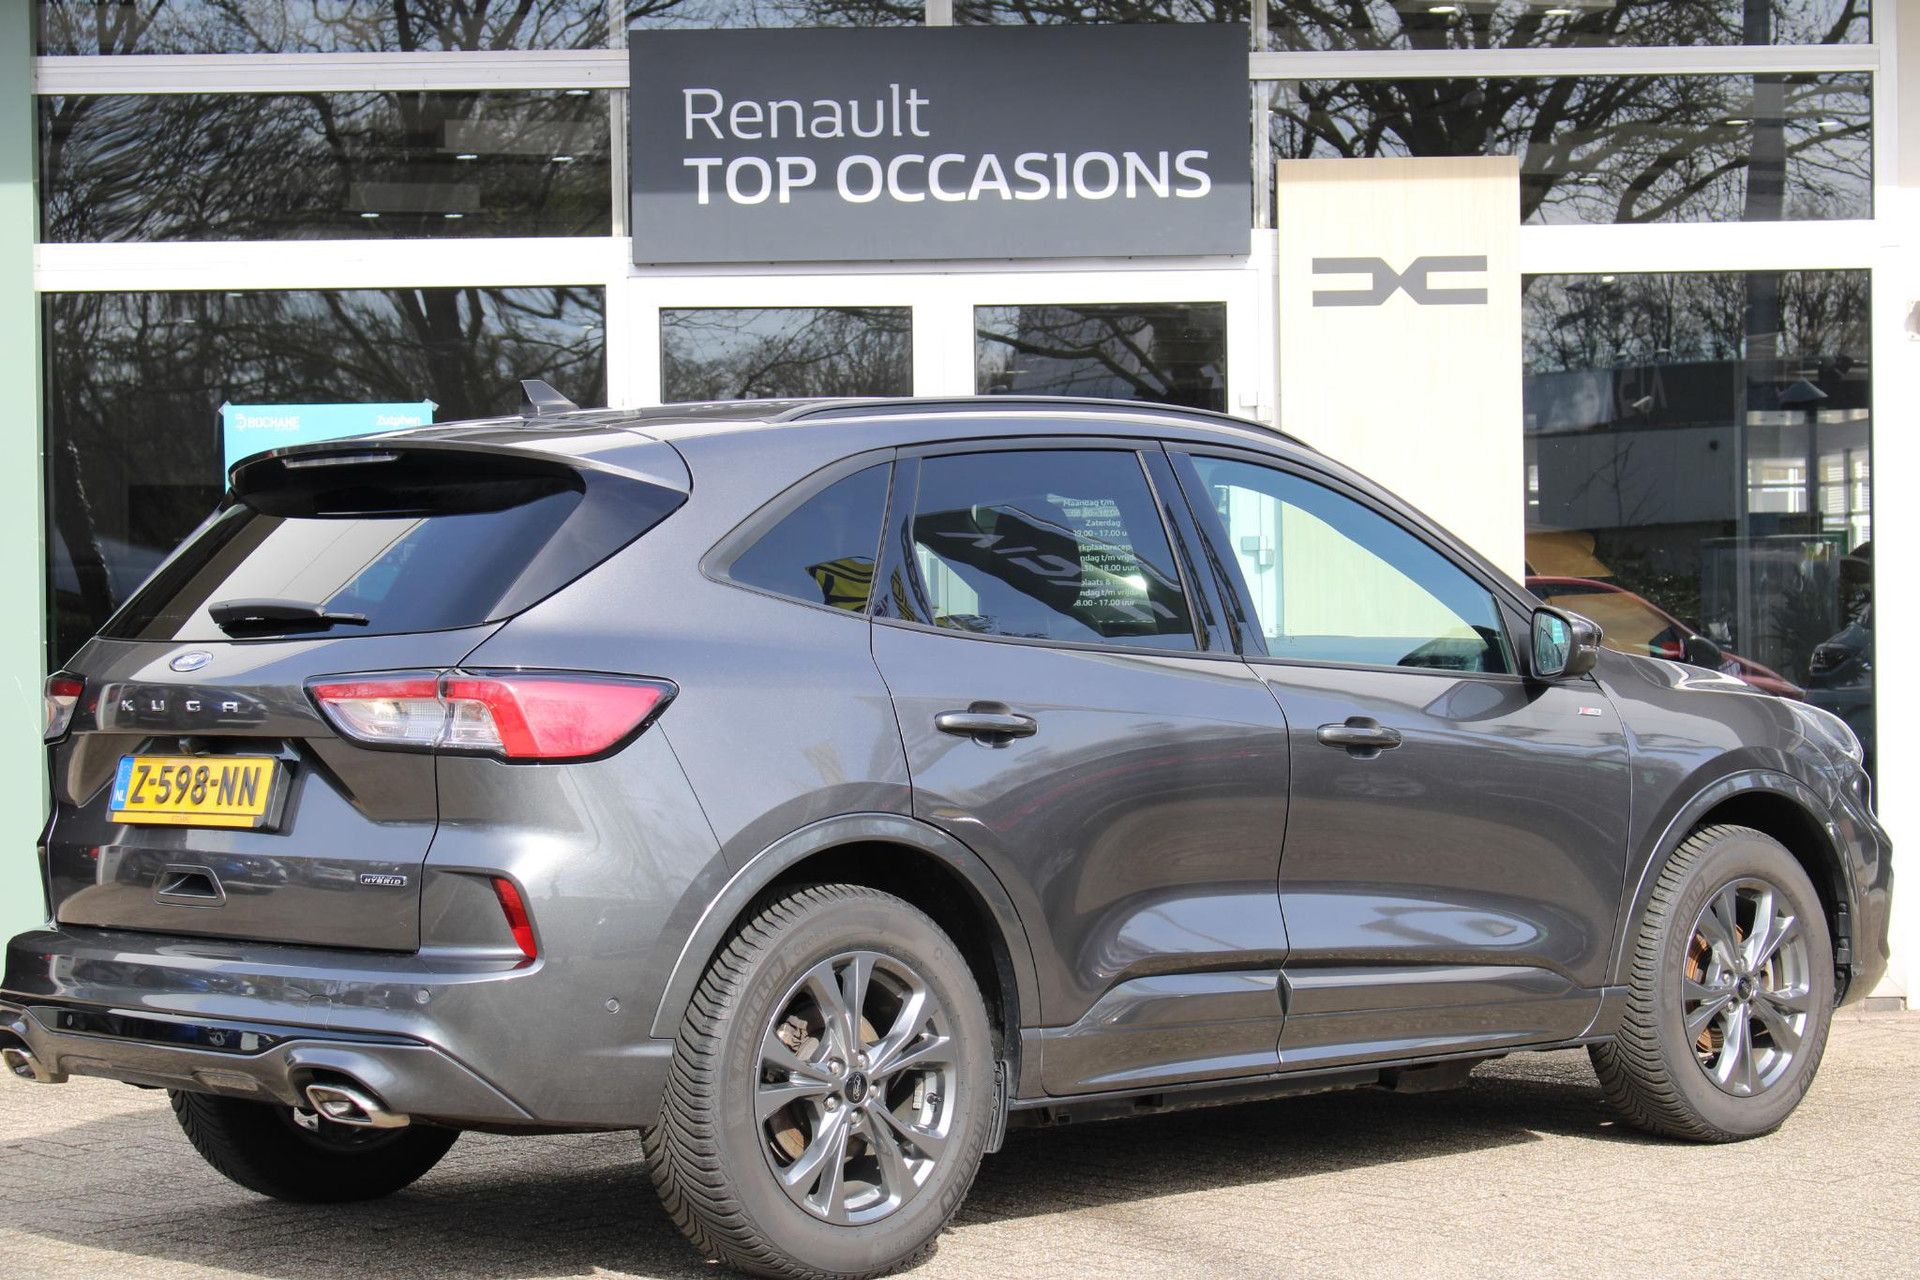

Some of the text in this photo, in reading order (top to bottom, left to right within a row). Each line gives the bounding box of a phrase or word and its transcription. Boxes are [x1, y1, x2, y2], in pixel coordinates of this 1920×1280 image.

[682, 83, 930, 141] Renault
[682, 150, 1212, 205] TOP OCCASIONS
[1086, 519, 1121, 527] Zaterdag
[1100, 529, 1121, 537] 17.00
[1100, 599, 1120, 607] 17.00
[129, 764, 262, 807] Z-598-NN
[115, 788, 126, 802] NL
